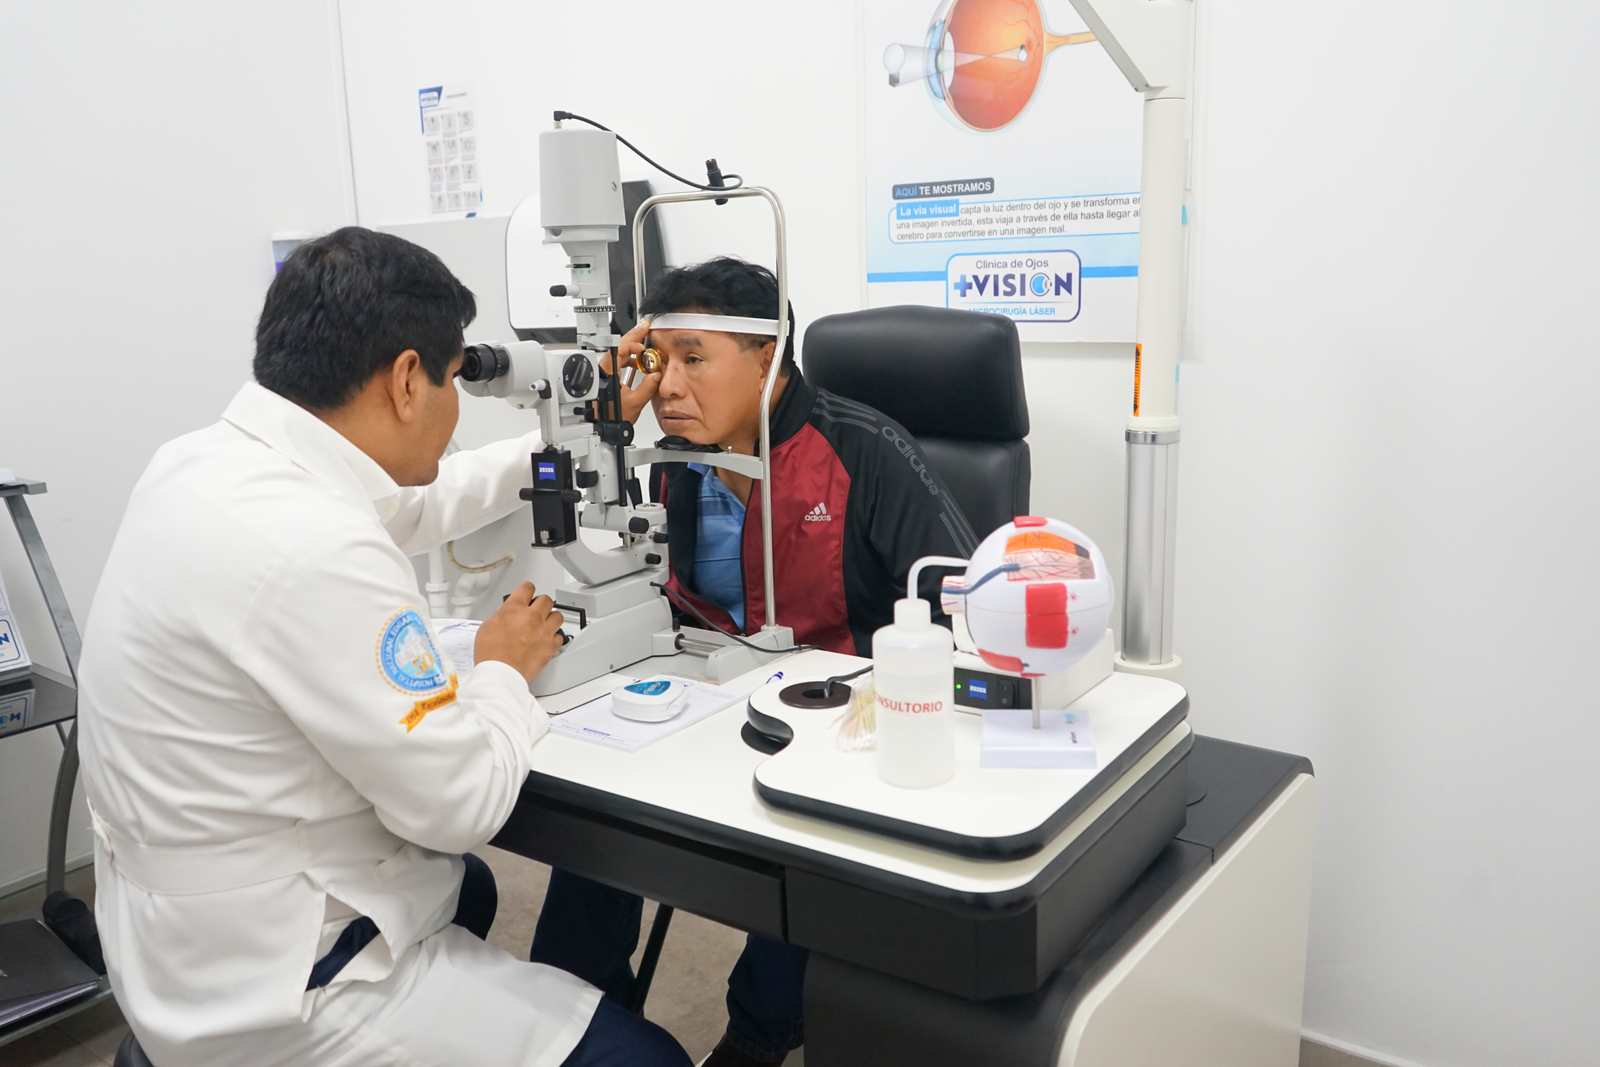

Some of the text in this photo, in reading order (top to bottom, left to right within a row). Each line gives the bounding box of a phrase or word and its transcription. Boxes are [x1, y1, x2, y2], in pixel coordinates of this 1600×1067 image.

[895, 181, 991, 197] AQUÍ TE MOSTRAMOS
[900, 207, 911, 216] La
[929, 203, 957, 214] visual
[960, 205, 982, 215] capta
[983, 204, 990, 212] la
[992, 204, 1004, 212] luz
[1006, 202, 1032, 212] dentro
[1033, 201, 1046, 210] del
[1048, 200, 1061, 211] ojo
[1063, 201, 1069, 210] y
[1070, 200, 1081, 208] se
[1083, 196, 1130, 208] transforma
[896, 222, 910, 230] una
[912, 220, 939, 230] imagen
[940, 218, 975, 227] invertida,
[976, 217, 993, 225] esta
[995, 214, 1014, 226] viaja
[1015, 215, 1021, 223] a
[1023, 212, 1048, 223] través
[1050, 212, 1061, 221] de
[1063, 211, 1078, 221] ella
[1080, 210, 1104, 220] hasta
[1106, 208, 1131, 220] llegar
[896, 224, 1067, 241] cerebro para convertirse en una imagen real.
[1010, 259, 1023, 268] de
[1025, 258, 1049, 270] Ojos
[1029, 306, 1056, 315] LÁSER
[881, 425, 939, 496] adidas
[804, 514, 832, 522] adidas
[412, 652, 435, 676] 50
